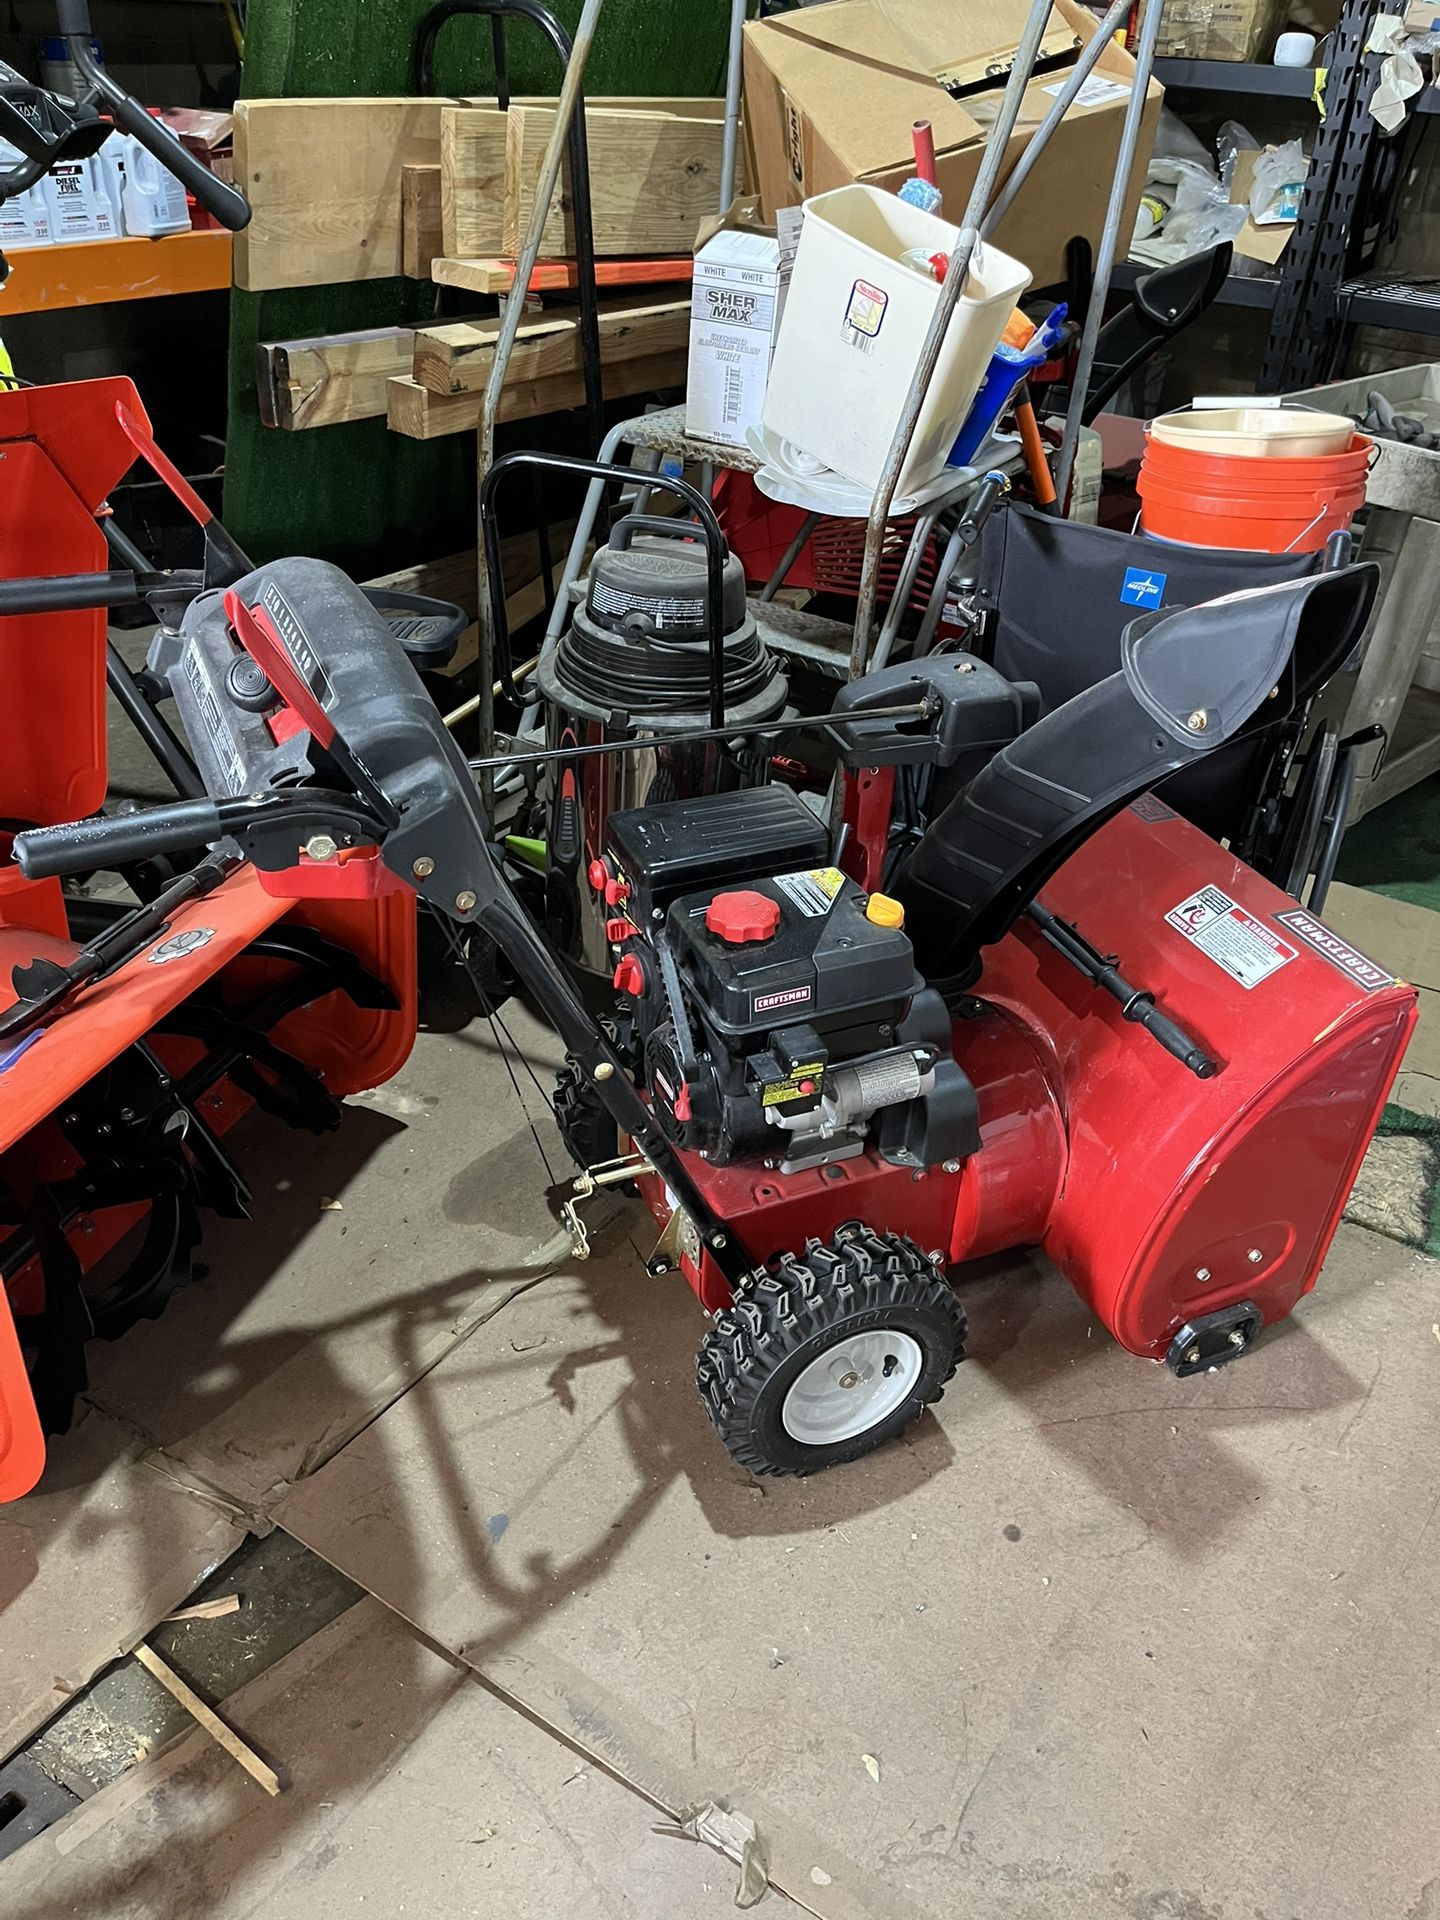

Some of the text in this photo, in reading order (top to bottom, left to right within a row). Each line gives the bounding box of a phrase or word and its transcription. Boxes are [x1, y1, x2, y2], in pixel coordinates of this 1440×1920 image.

[55, 177, 81, 185] DIESEL
[60, 184, 79, 192] FUEL
[704, 265, 764, 283] WHITE WHITE
[707, 290, 756, 309] SHER
[859, 282, 884, 301] Sterilite
[712, 305, 750, 323] MAX
[1249, 919, 1280, 948] DANGER
[1290, 916, 1380, 981] CRAFTSMAN
[758, 989, 808, 1008] CRAFTSMAN
